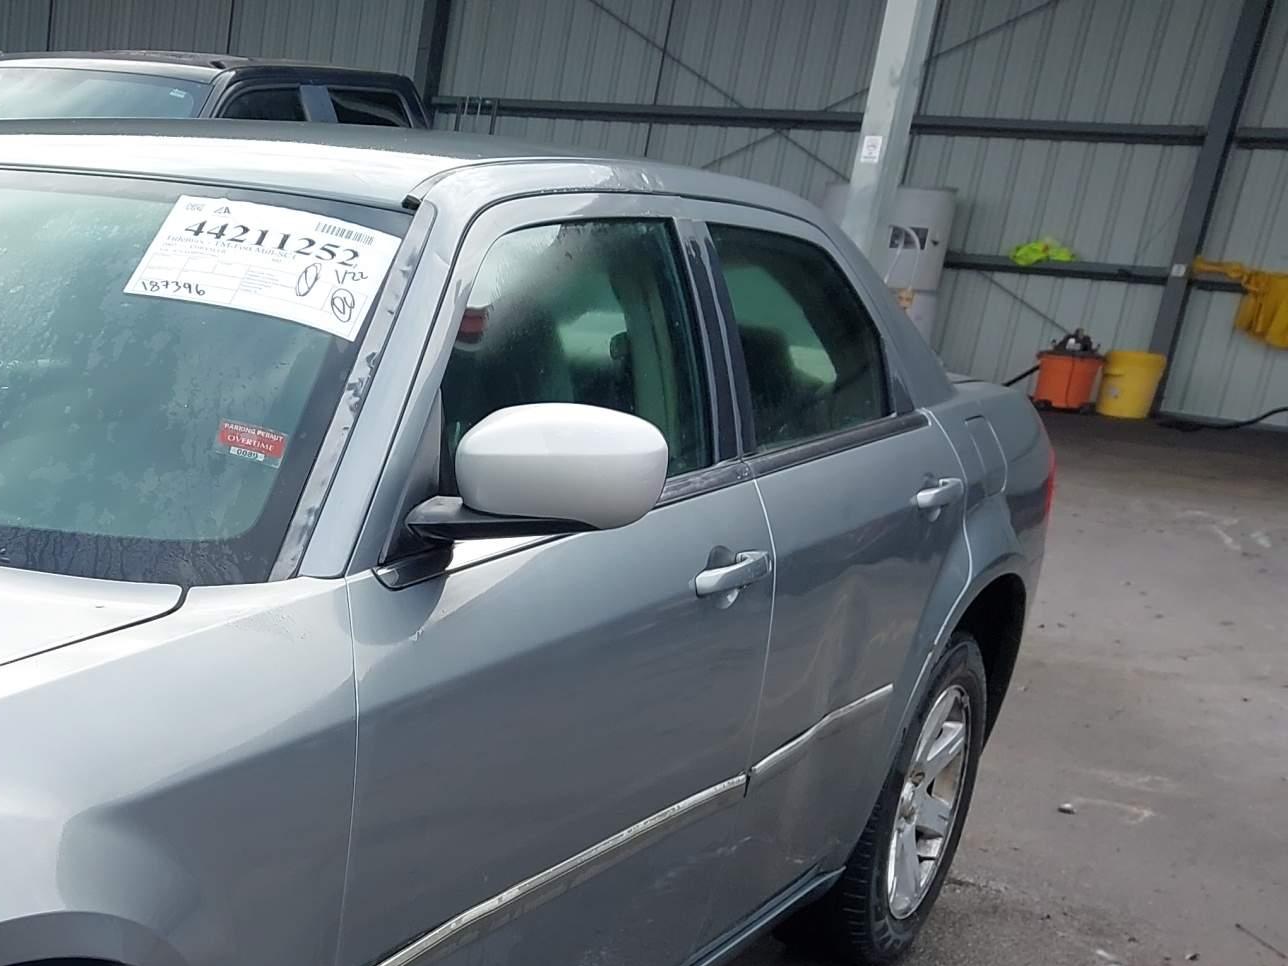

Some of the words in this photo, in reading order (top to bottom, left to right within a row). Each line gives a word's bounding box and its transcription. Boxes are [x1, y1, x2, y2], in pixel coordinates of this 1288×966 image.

[184, 220, 359, 267] 44211252
[141, 280, 206, 297] 187396
[224, 423, 256, 434] PARKING
[256, 430, 284, 442] PERMIT
[227, 435, 274, 451] OVERTIME
